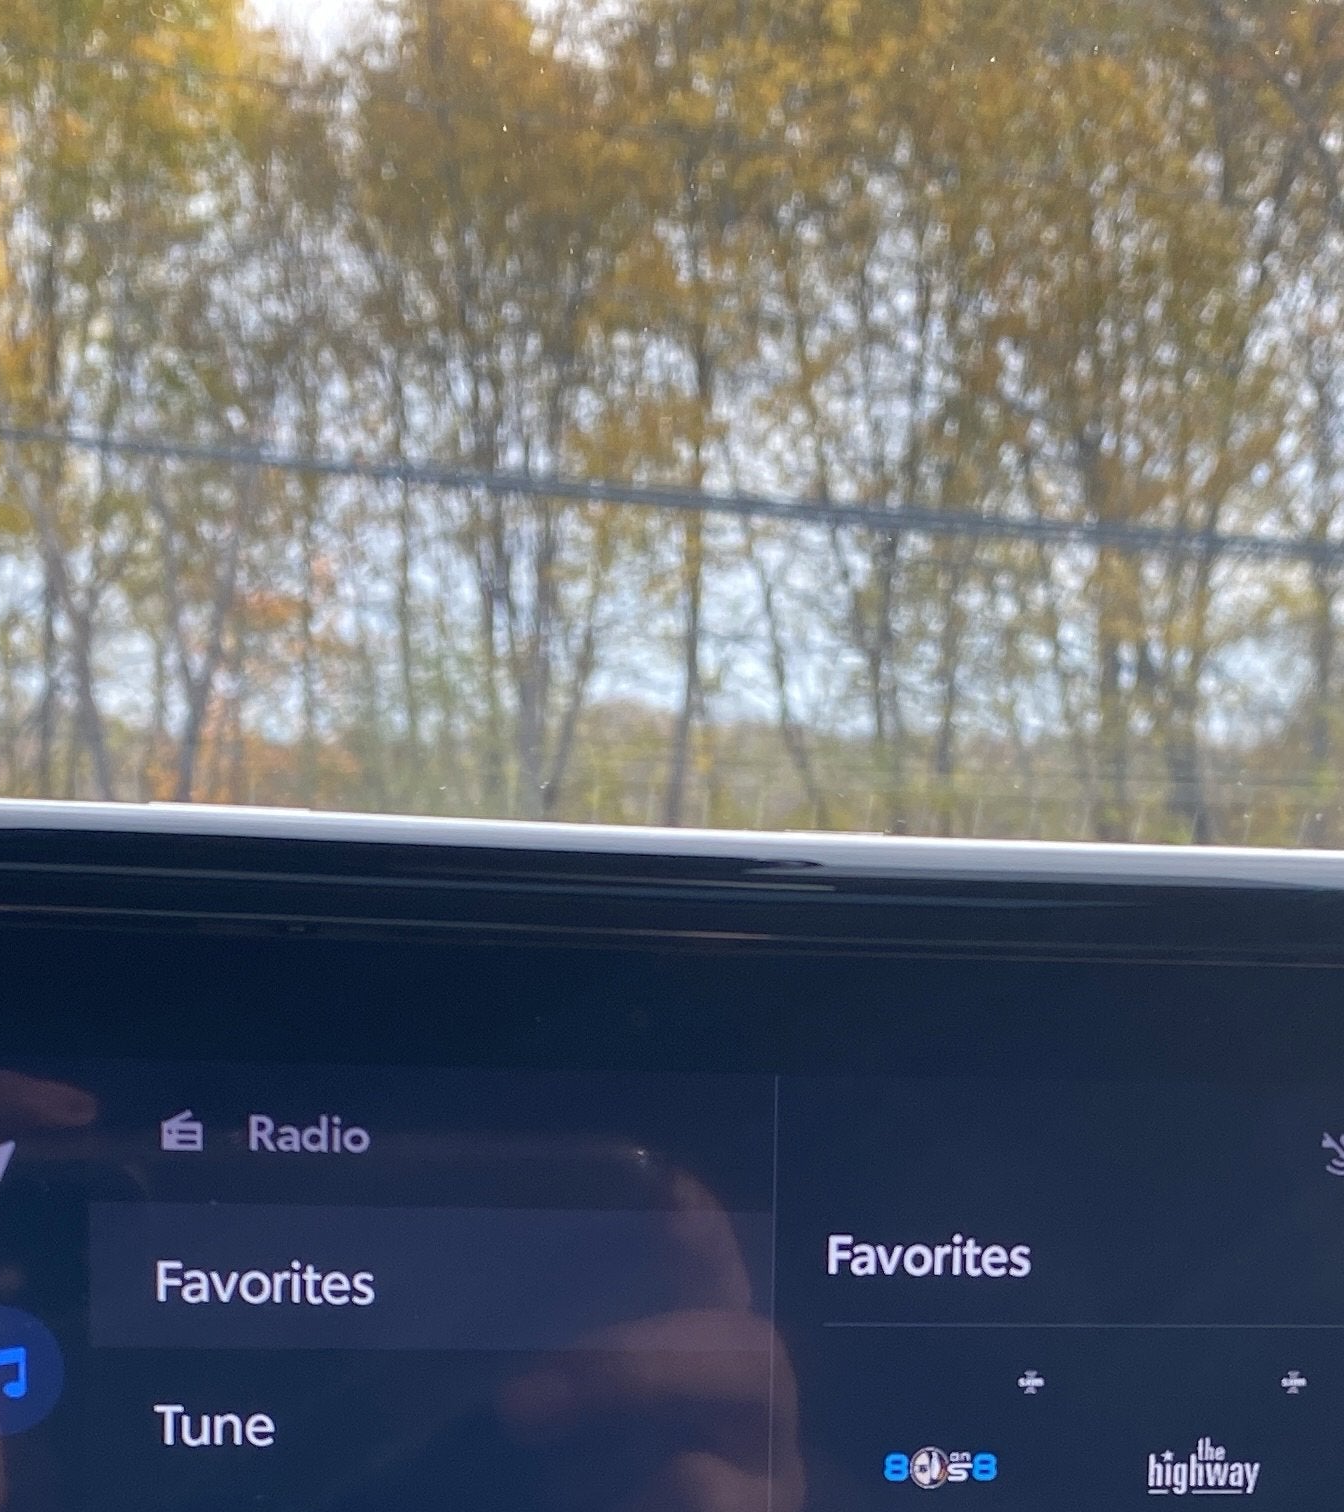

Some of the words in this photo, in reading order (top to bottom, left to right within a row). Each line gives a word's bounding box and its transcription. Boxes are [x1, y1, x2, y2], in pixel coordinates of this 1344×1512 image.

[249, 1114, 371, 1155] Radio
[827, 1233, 1033, 1278] Favorites
[156, 1260, 376, 1306] Favorites
[153, 1404, 276, 1447] Tune
[1197, 1436, 1226, 1461] the
[1147, 1450, 1261, 1494] highway
